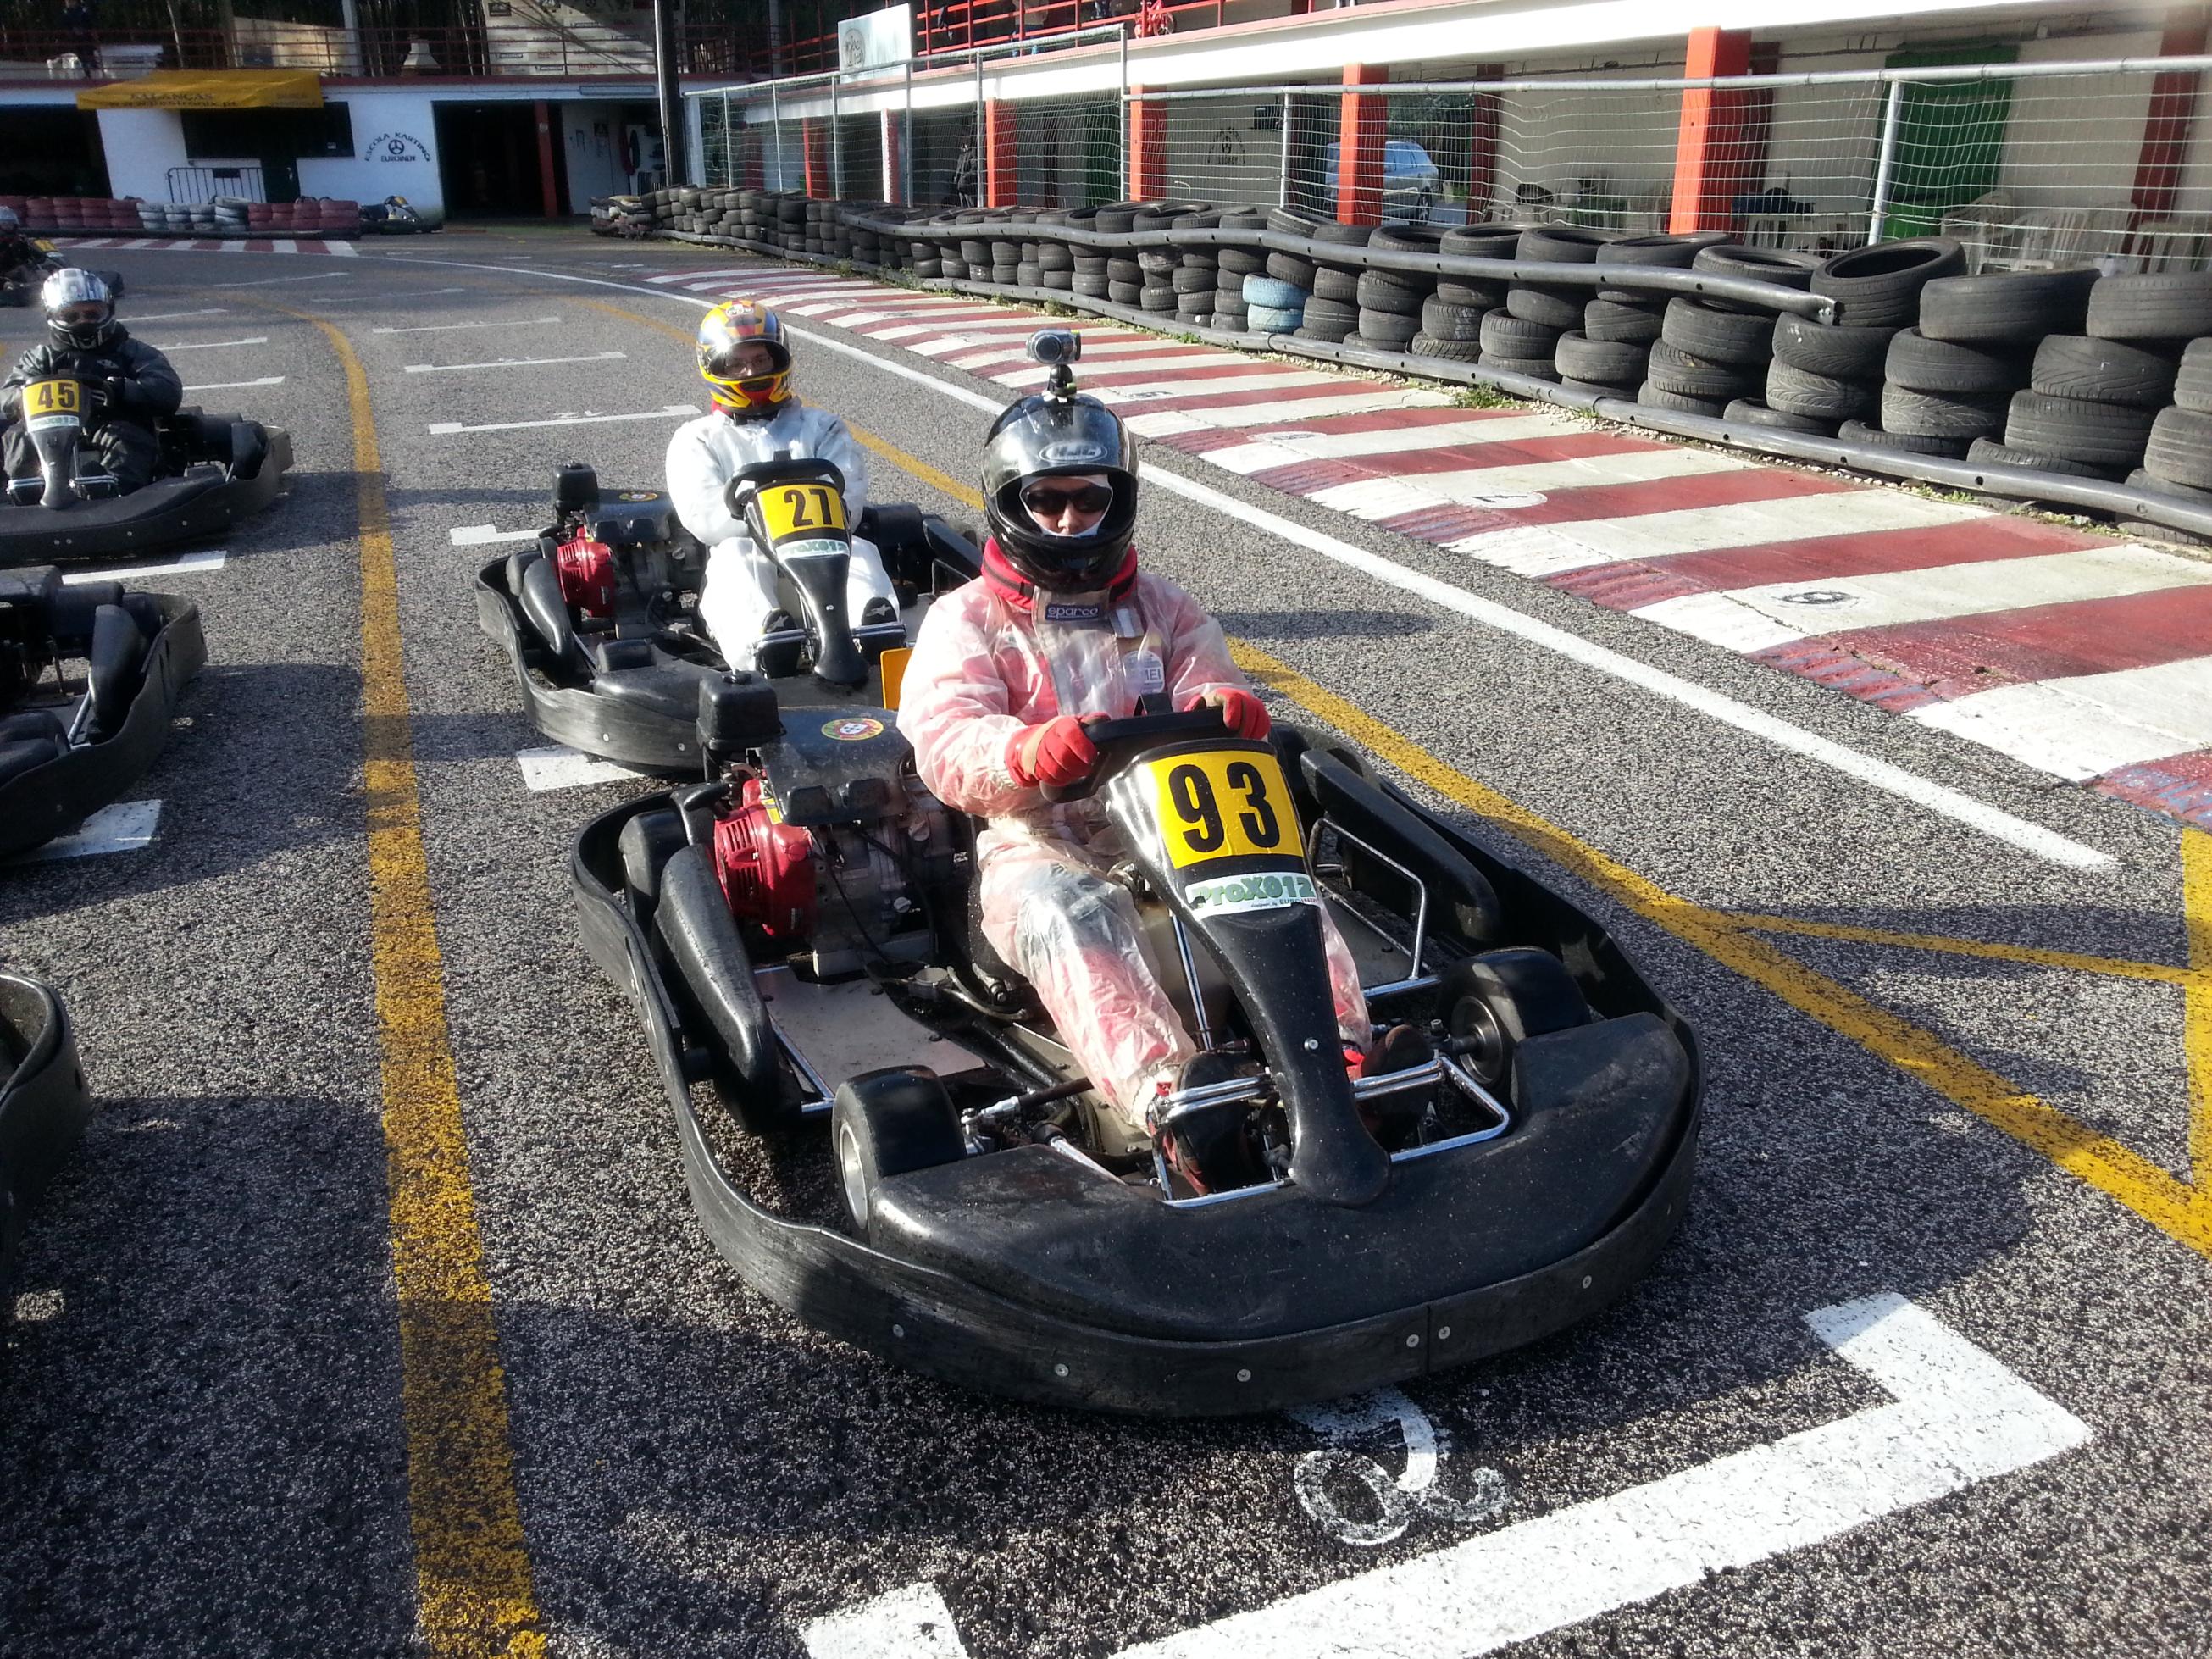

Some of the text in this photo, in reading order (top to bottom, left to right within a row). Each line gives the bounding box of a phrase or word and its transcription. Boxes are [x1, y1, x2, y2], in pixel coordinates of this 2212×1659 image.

[364, 132, 431, 162] ESCOLA KARTING
[37, 381, 75, 408] 45
[784, 488, 833, 528] 27
[1047, 607, 1099, 619] sparco
[1168, 761, 1281, 853] 93
